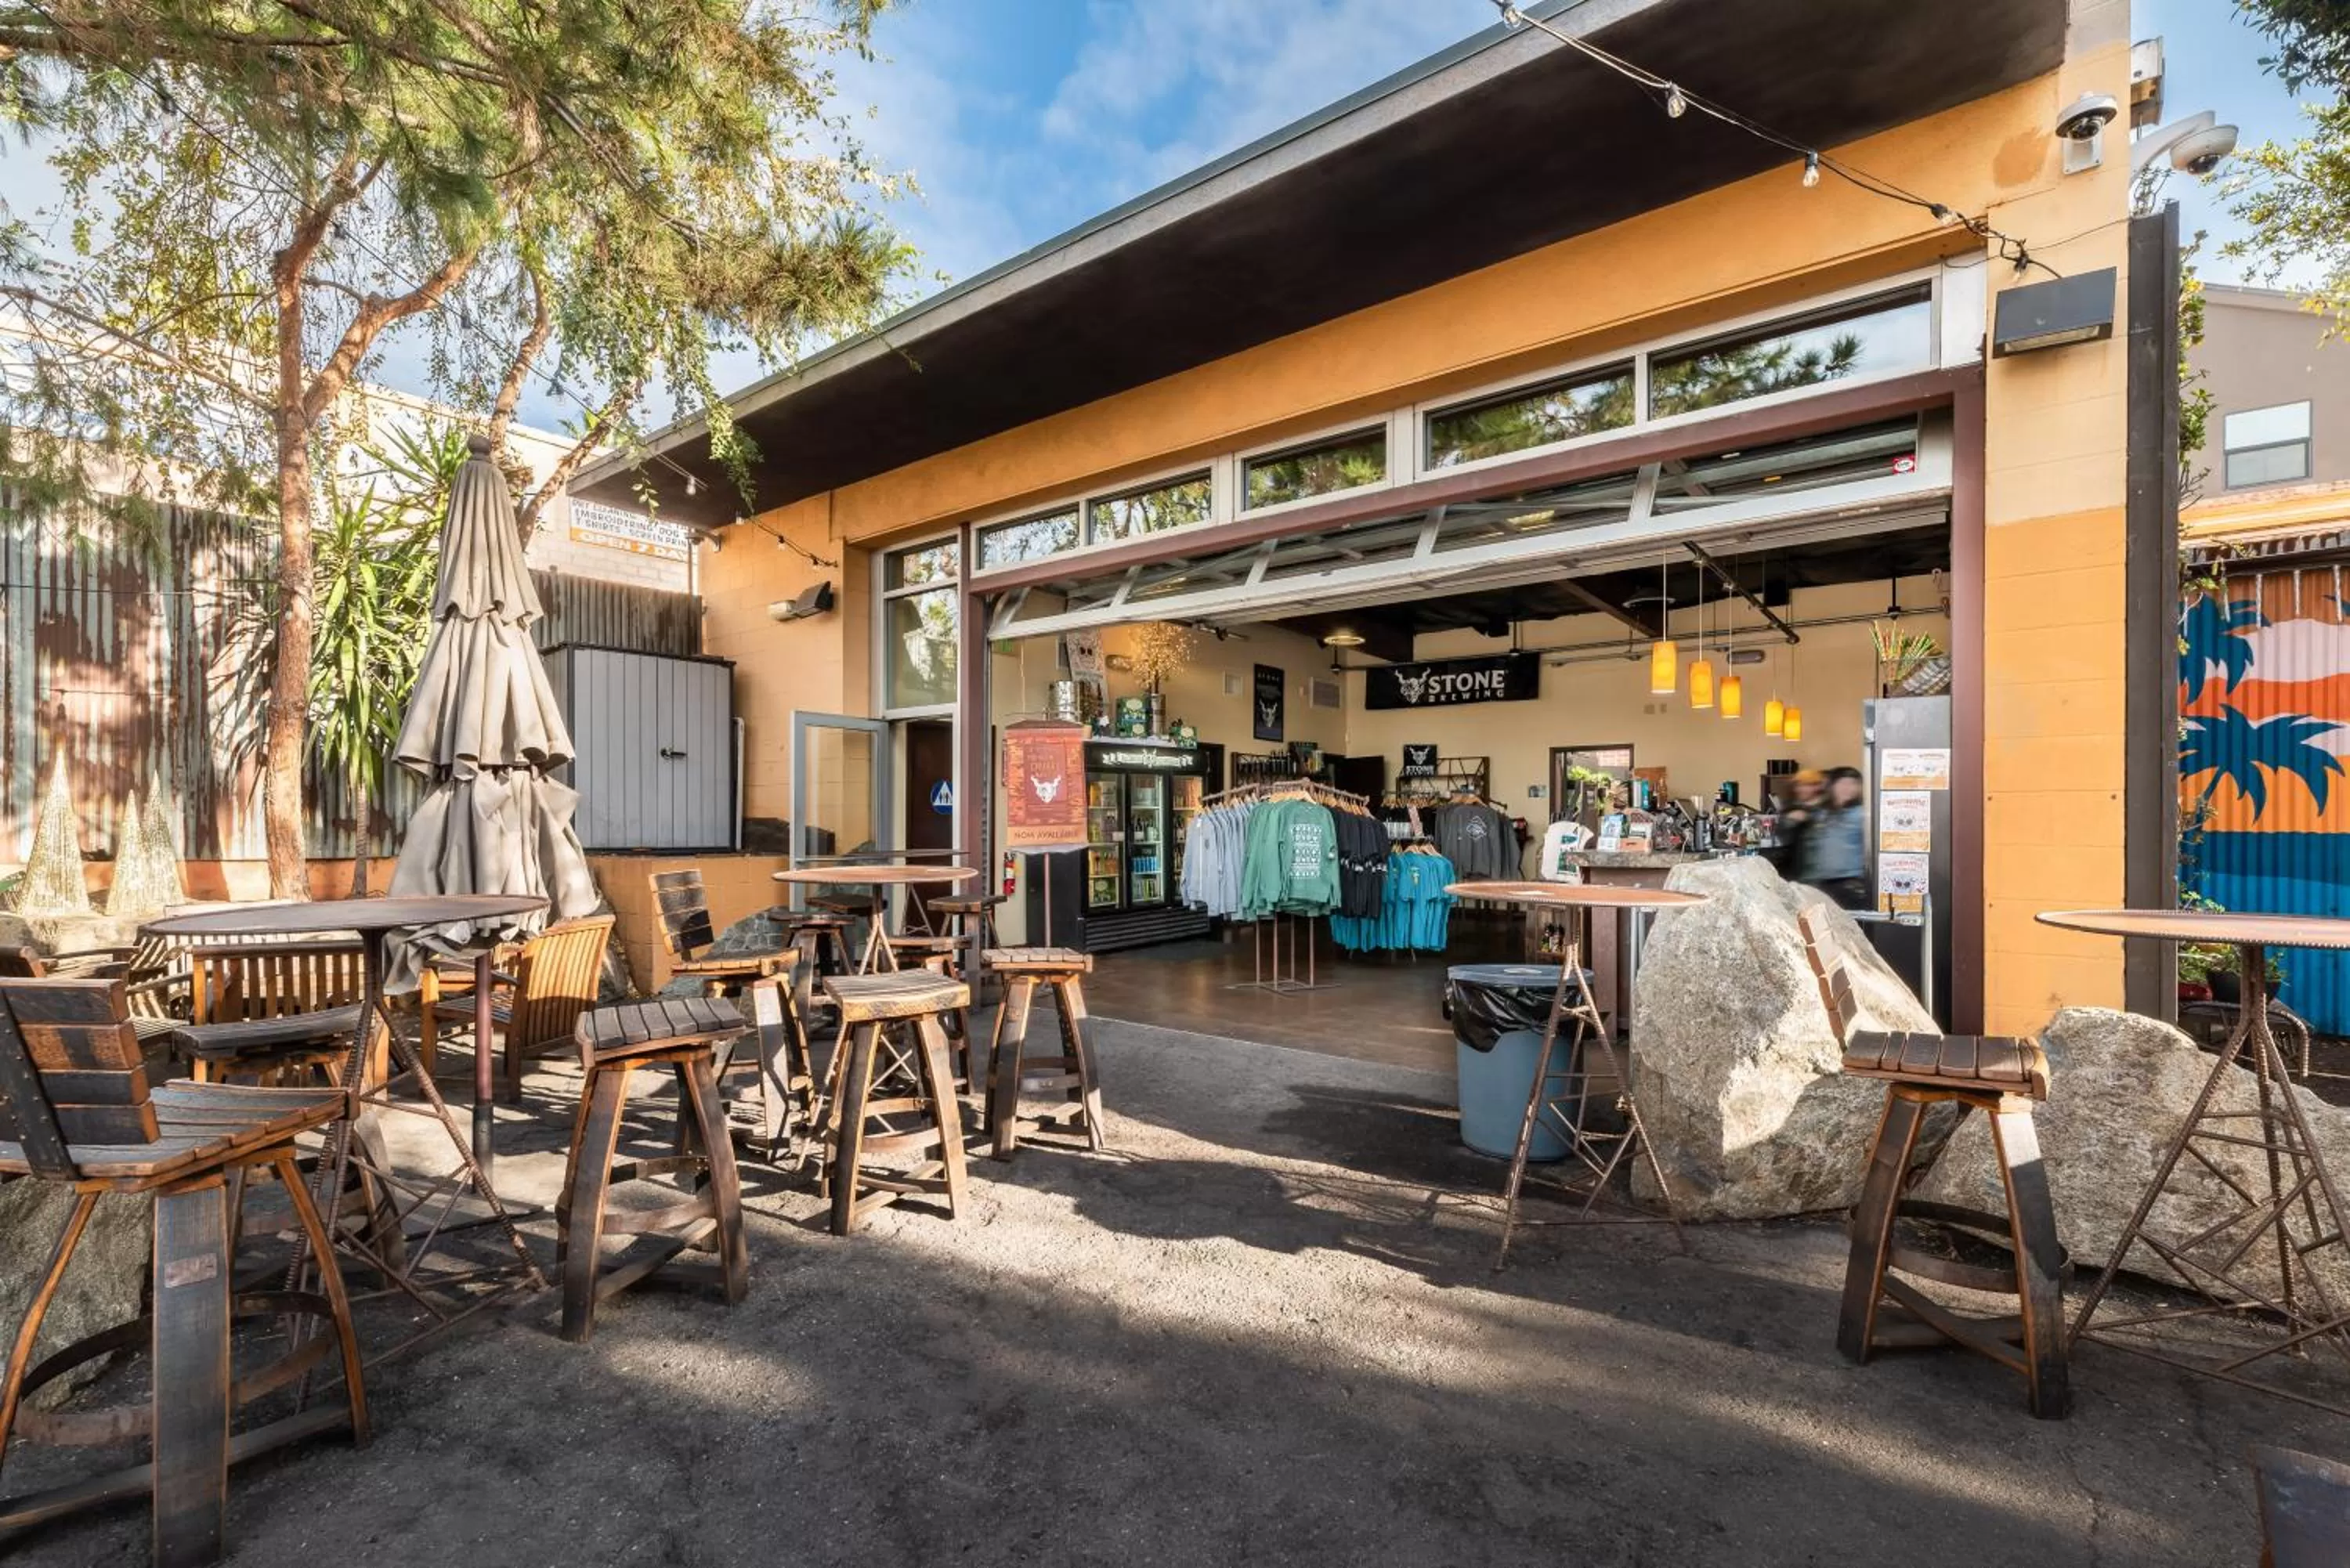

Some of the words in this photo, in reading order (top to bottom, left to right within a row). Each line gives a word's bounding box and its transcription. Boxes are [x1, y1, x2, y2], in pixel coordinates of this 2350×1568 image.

[629, 529, 663, 543] SCREEN
[659, 527, 680, 538] DOG
[580, 531, 631, 549] OPEN
[1428, 670, 1505, 694] STONE
[1428, 689, 1505, 703] BREWING
